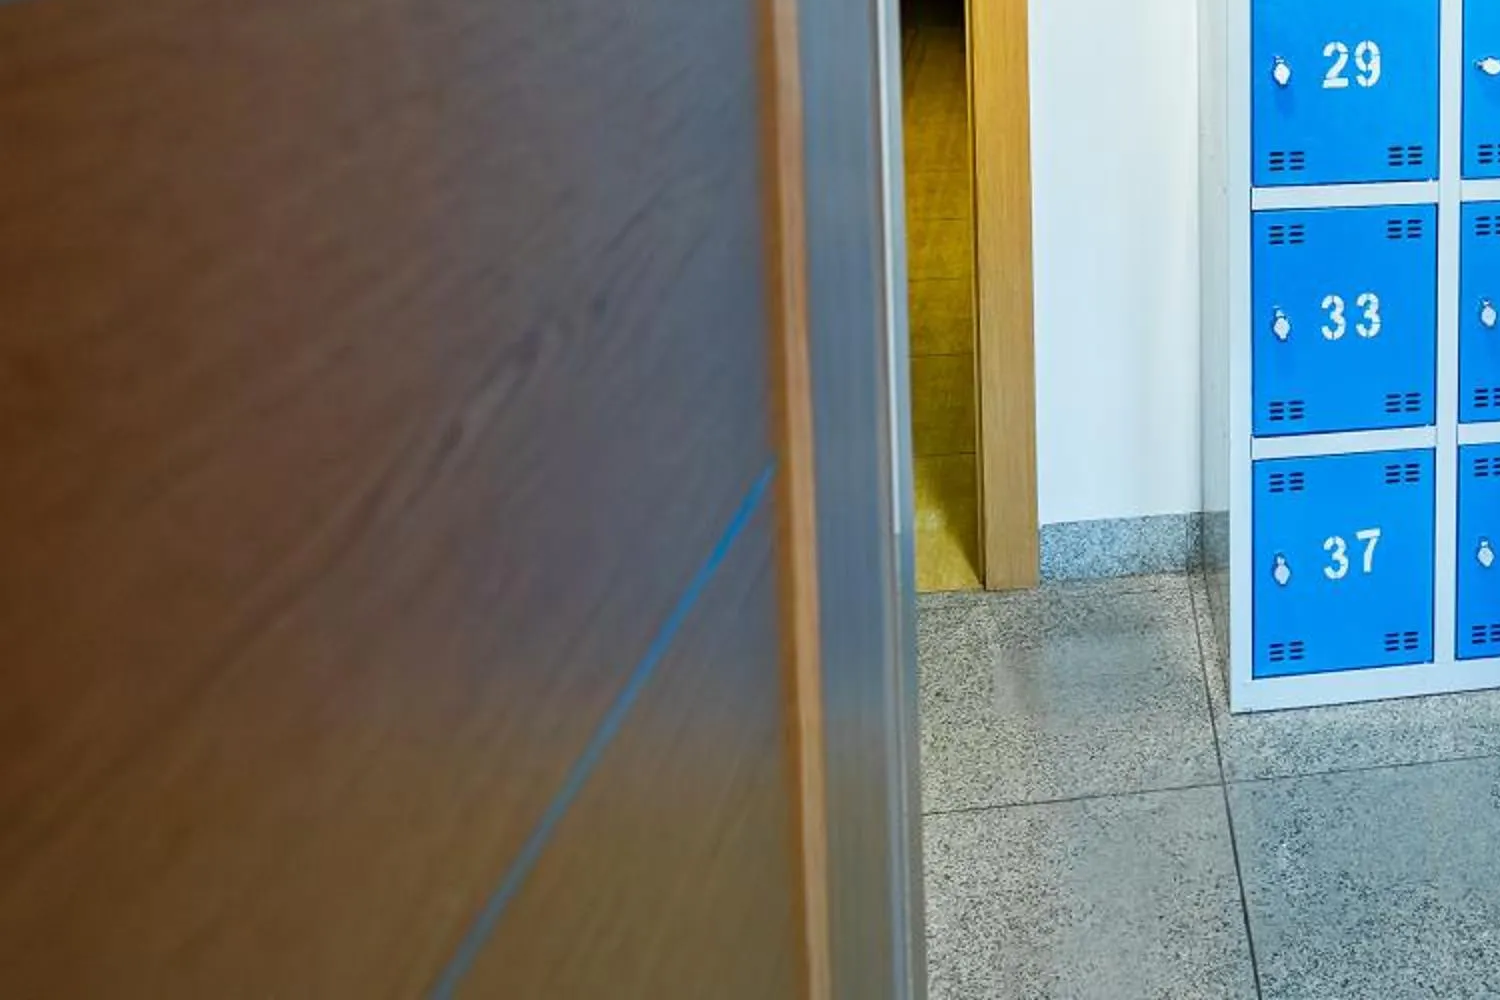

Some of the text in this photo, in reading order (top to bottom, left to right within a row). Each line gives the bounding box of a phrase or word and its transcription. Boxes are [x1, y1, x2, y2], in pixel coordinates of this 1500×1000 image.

[1322, 40, 1381, 89] 29
[1321, 293, 1381, 340] 33
[1323, 528, 1381, 579] 37
